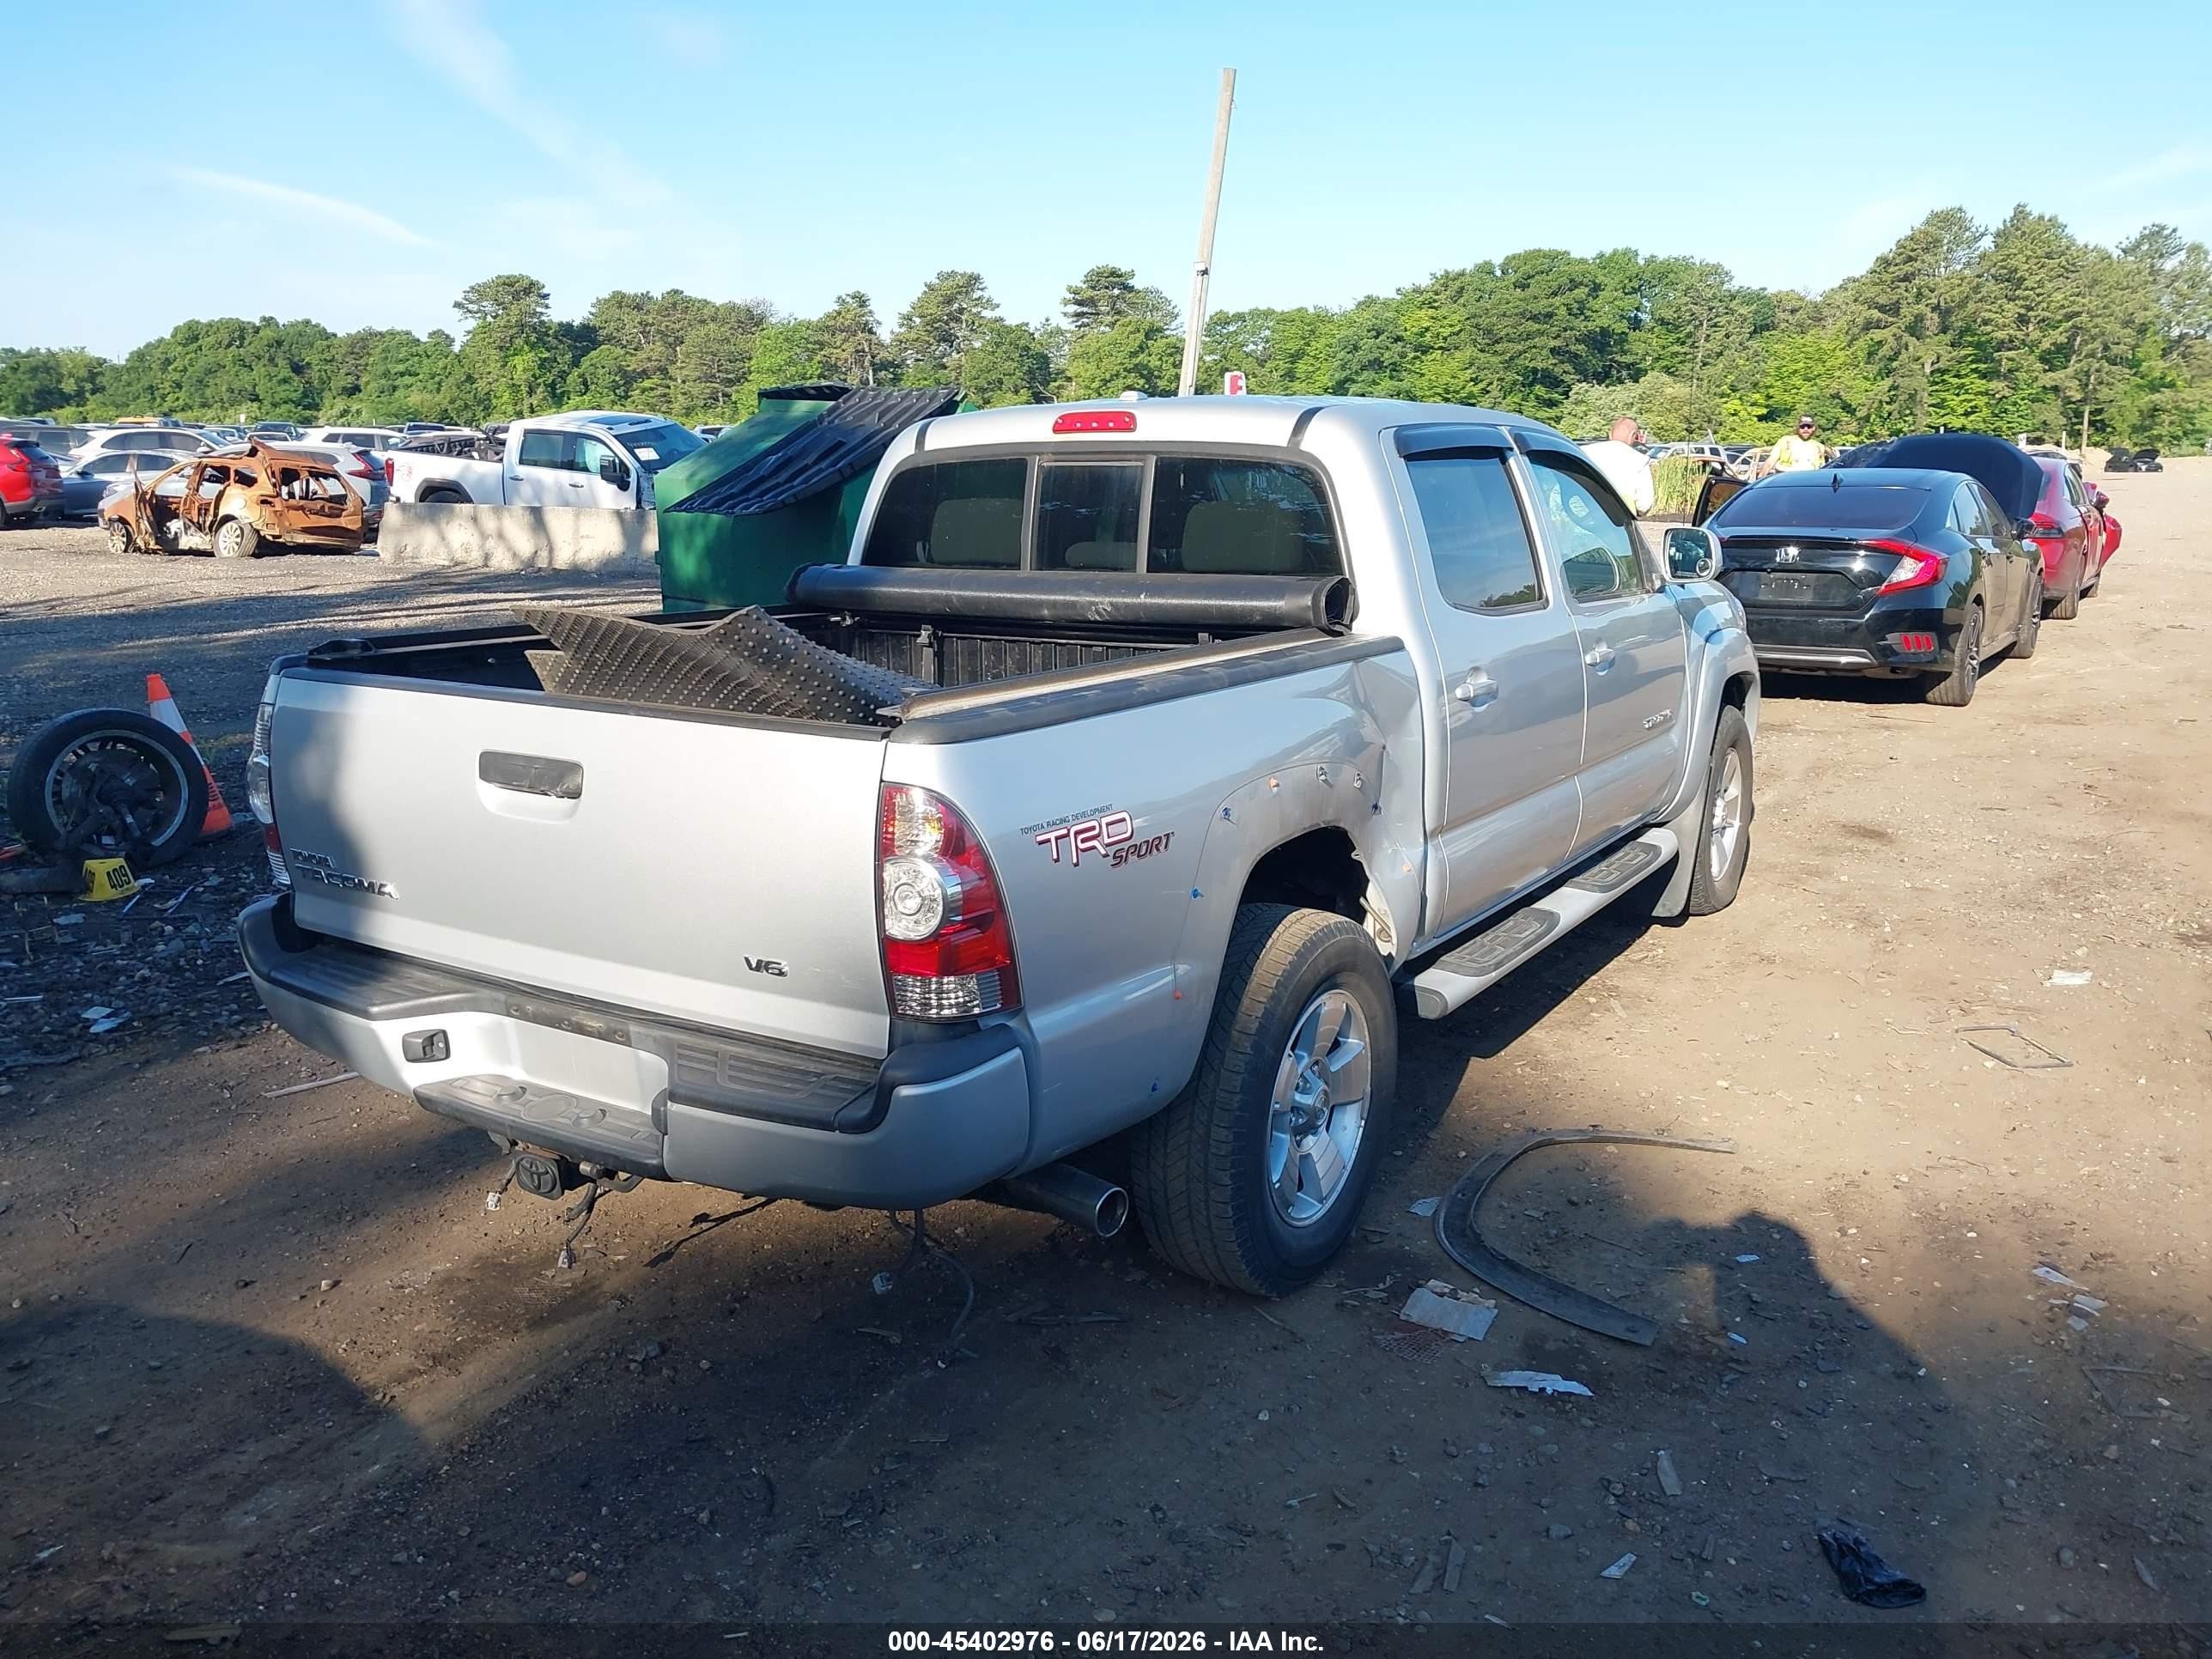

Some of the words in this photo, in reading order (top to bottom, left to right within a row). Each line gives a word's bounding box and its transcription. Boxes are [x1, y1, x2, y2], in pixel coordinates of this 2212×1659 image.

[1020, 822, 1045, 836] TOYOTA
[1046, 816, 1071, 829] RACING
[1071, 804, 1114, 822] DEVELOPMENT
[1035, 810, 1133, 867] TRD
[1110, 831, 1175, 868] SPORT
[106, 864, 131, 890] 409
[295, 863, 399, 900] TACOMA
[743, 956, 789, 978] V6
